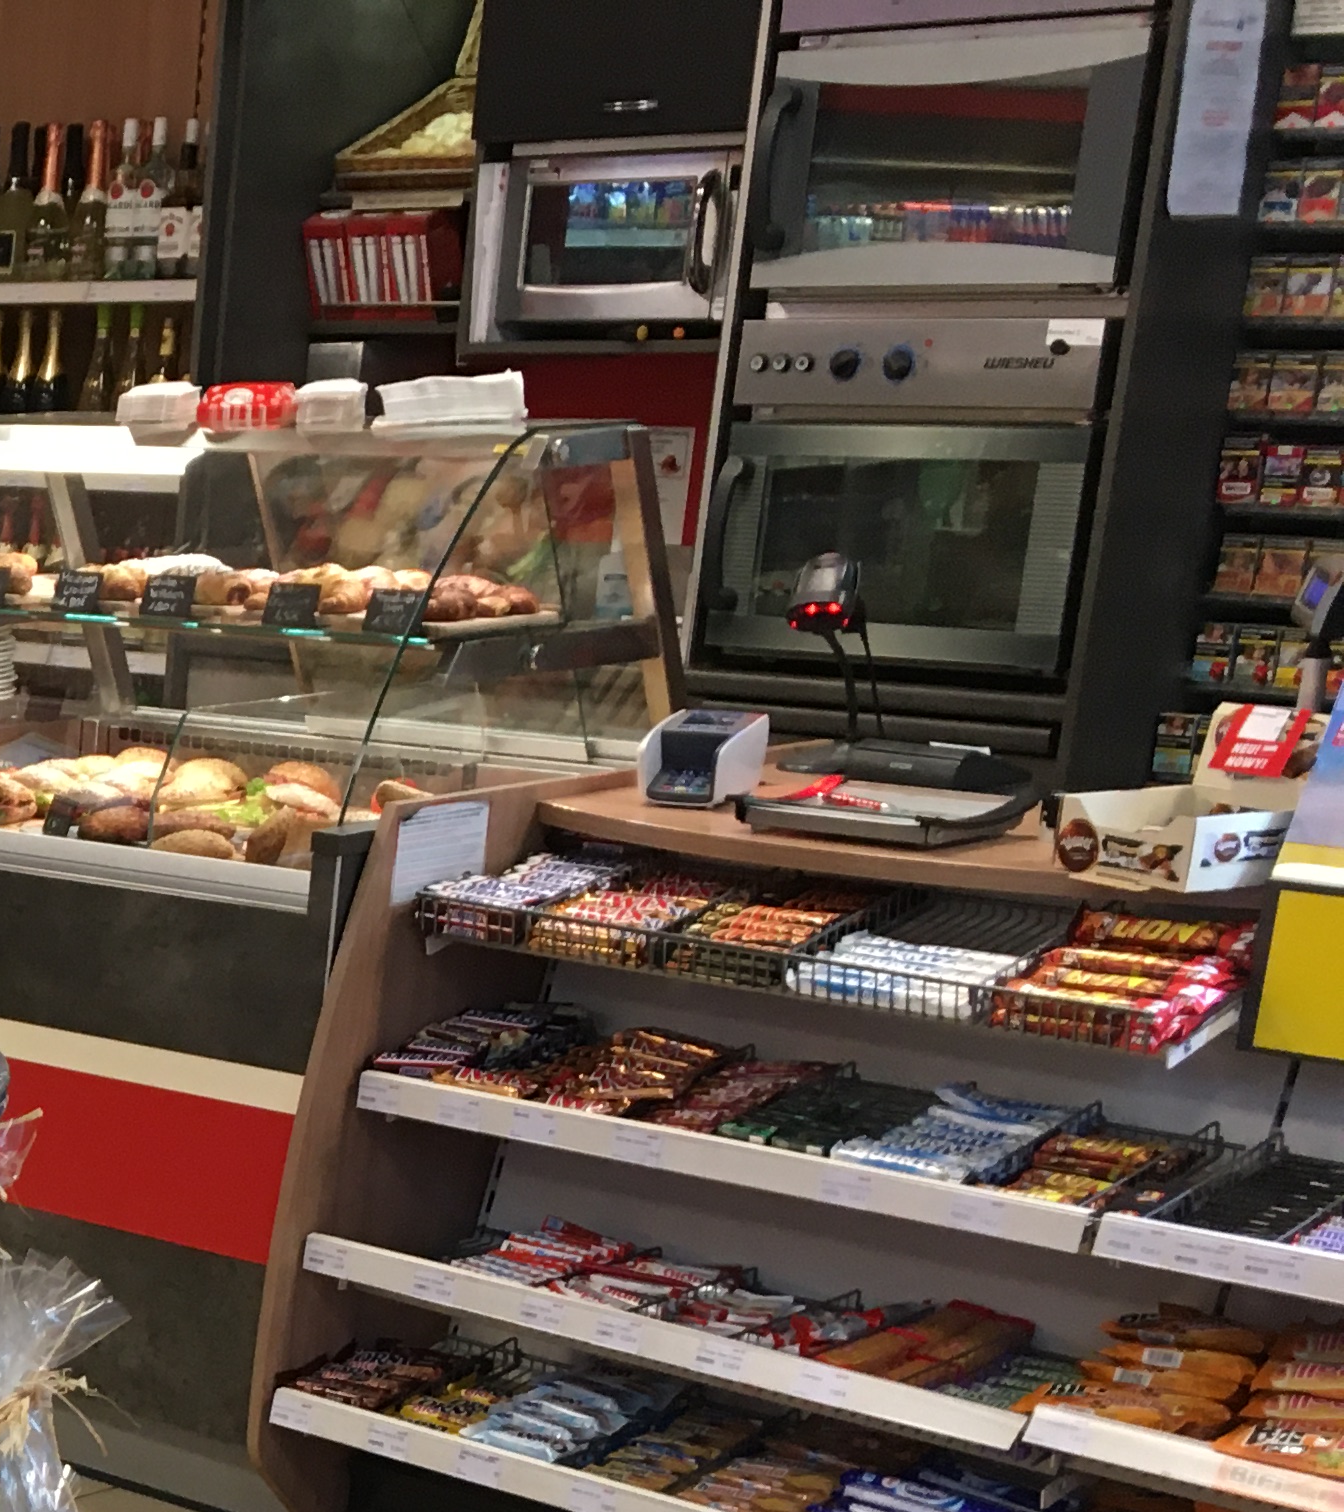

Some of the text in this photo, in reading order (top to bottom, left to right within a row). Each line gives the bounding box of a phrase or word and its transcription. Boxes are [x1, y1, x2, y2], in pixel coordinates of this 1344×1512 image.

[983, 356, 1055, 369] WIESHEU
[1231, 742, 1261, 755] NEU!
[1225, 756, 1269, 769] NOWY!
[1112, 919, 1201, 943] LION
[1228, 1465, 1284, 1492] BiFi
